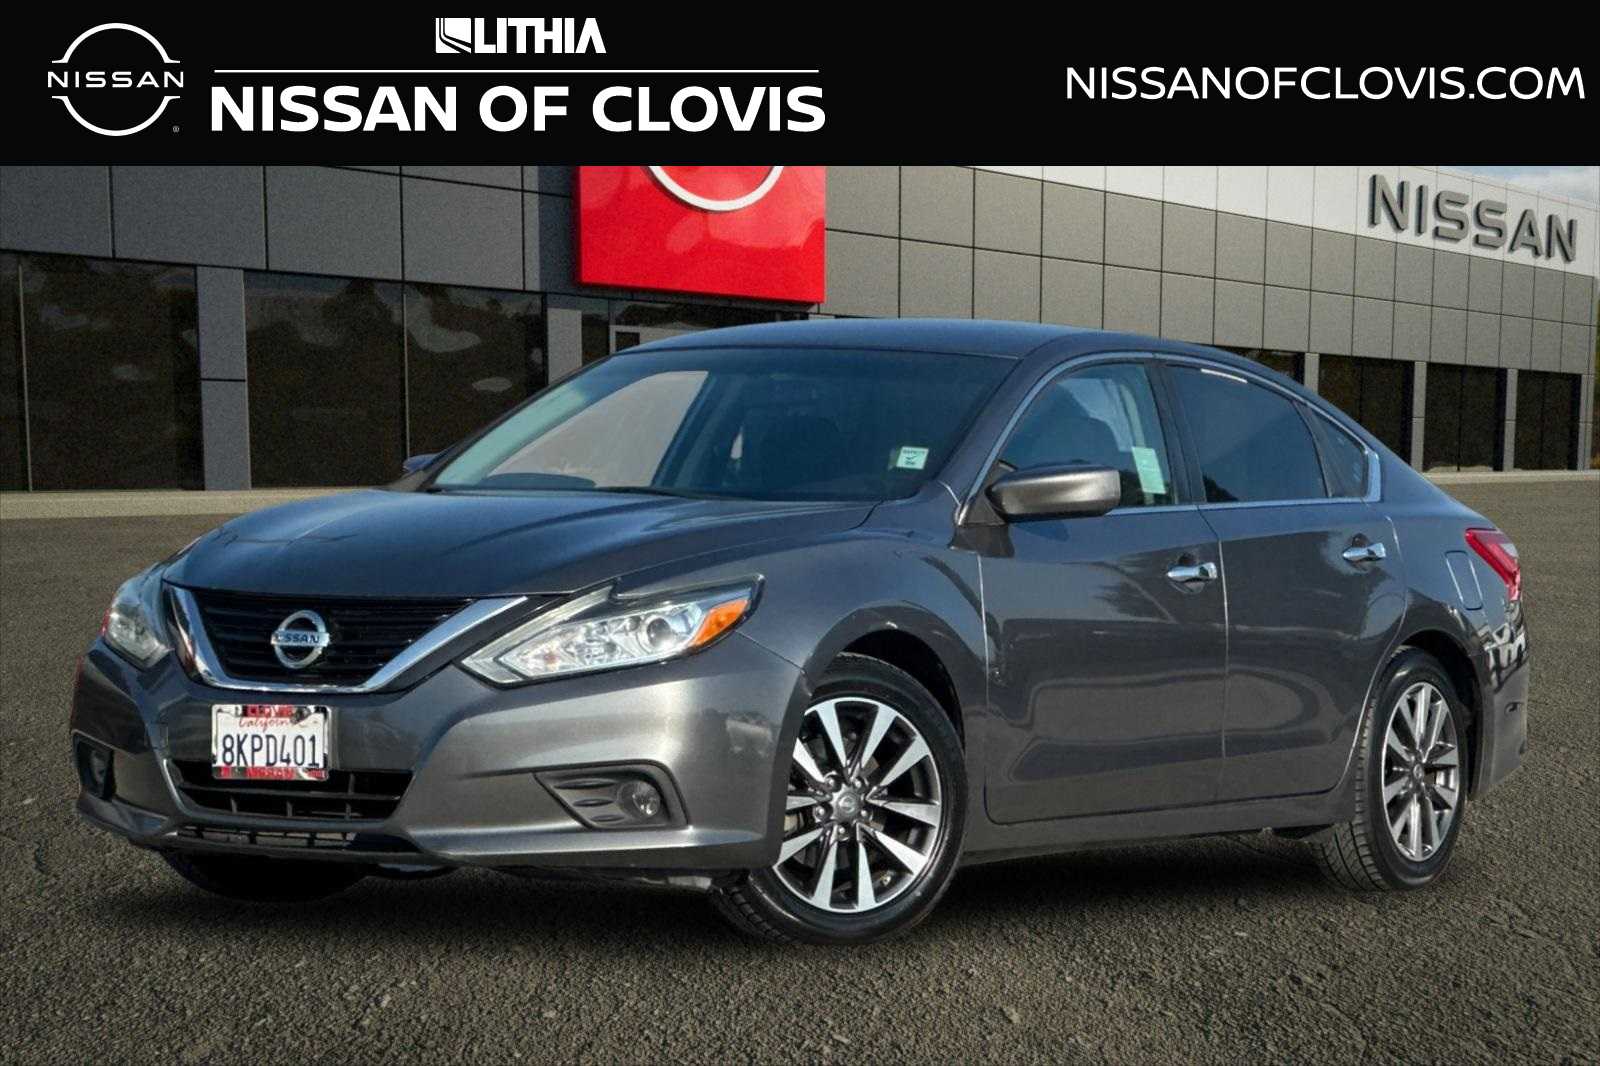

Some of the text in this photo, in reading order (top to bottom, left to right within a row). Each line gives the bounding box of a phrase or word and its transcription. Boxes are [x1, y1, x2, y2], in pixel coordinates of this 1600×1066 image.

[1368, 174, 1577, 263] NISSAN
[274, 632, 320, 644] SSAN
[238, 718, 299, 732] Californ
[222, 733, 320, 767] 8KPD401
